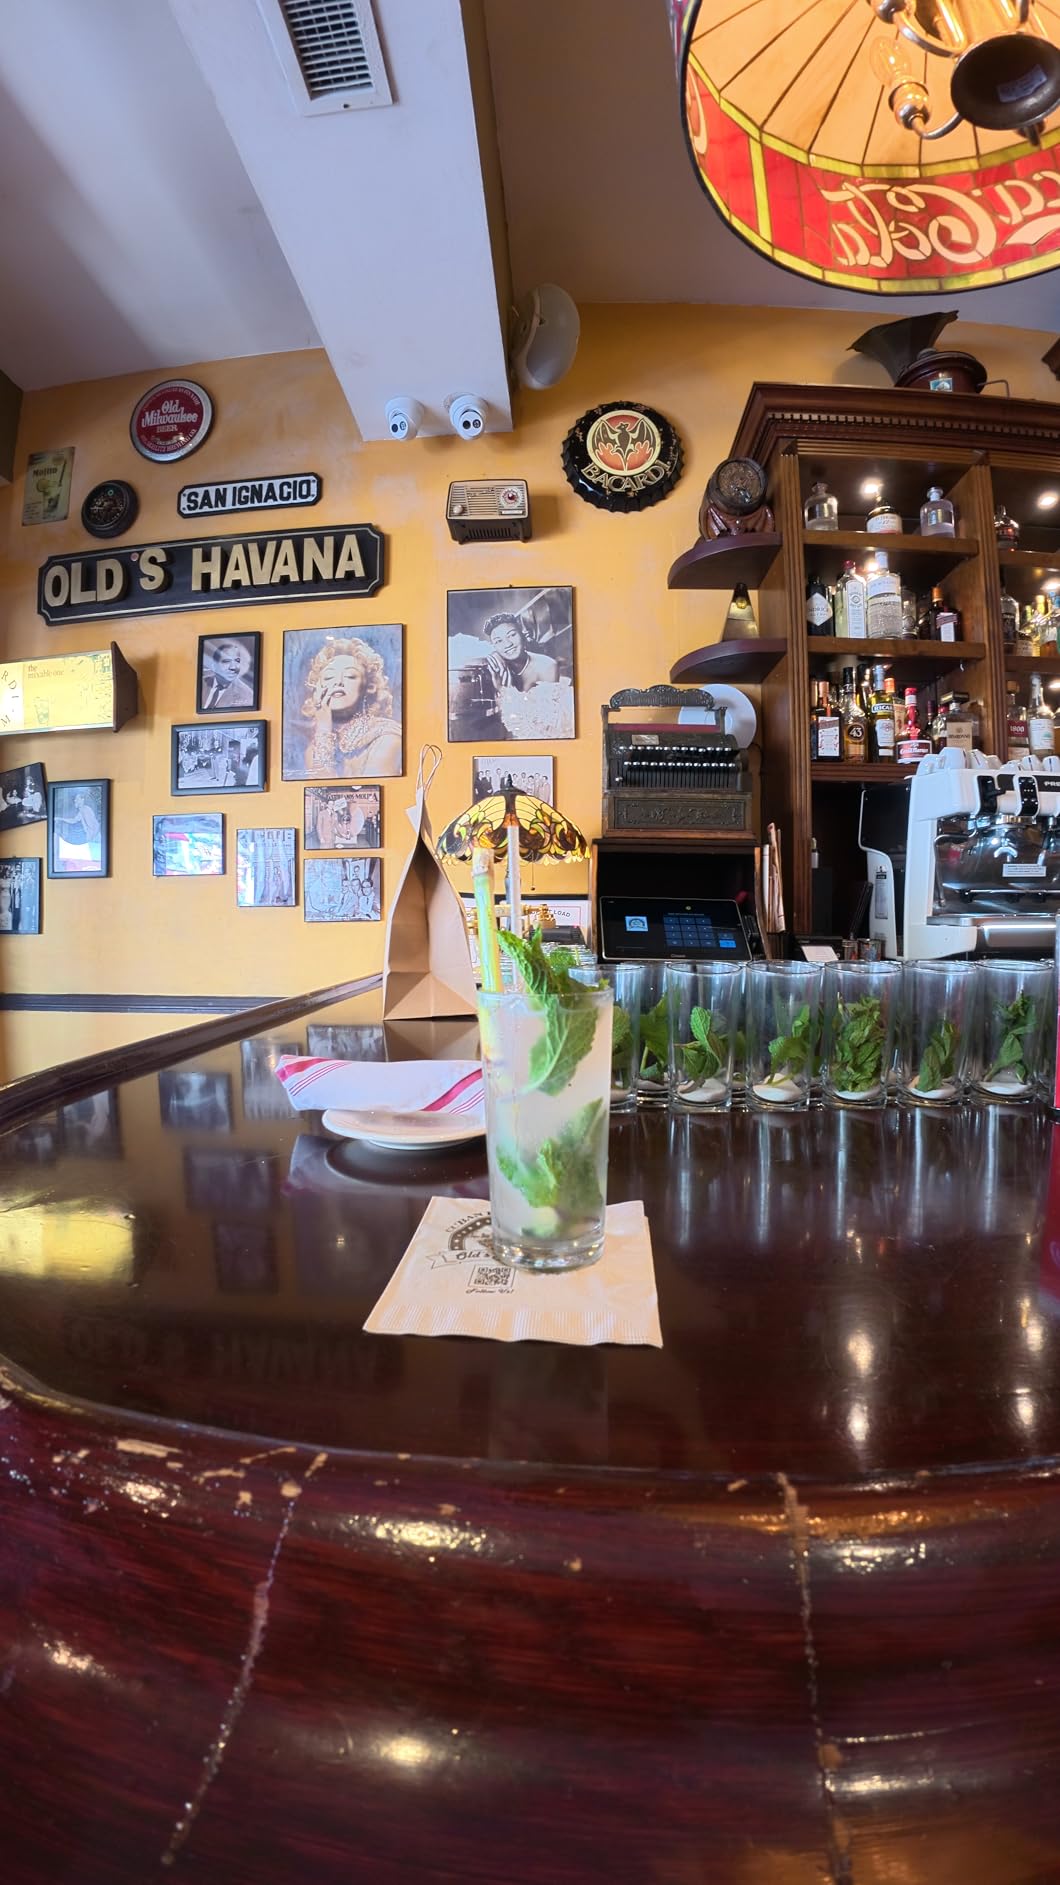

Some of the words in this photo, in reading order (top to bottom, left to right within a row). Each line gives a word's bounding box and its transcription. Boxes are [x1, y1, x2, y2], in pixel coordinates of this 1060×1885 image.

[161, 399, 181, 414] Old
[141, 407, 199, 428] Milwaukee
[185, 484, 228, 511] SAN
[232, 479, 313, 507] IGNACIO
[191, 533, 366, 591] HAVANA
[849, 727, 863, 738] 43
[553, 909, 571, 918] LOAD
[445, 1212, 483, 1233] CUBAN
